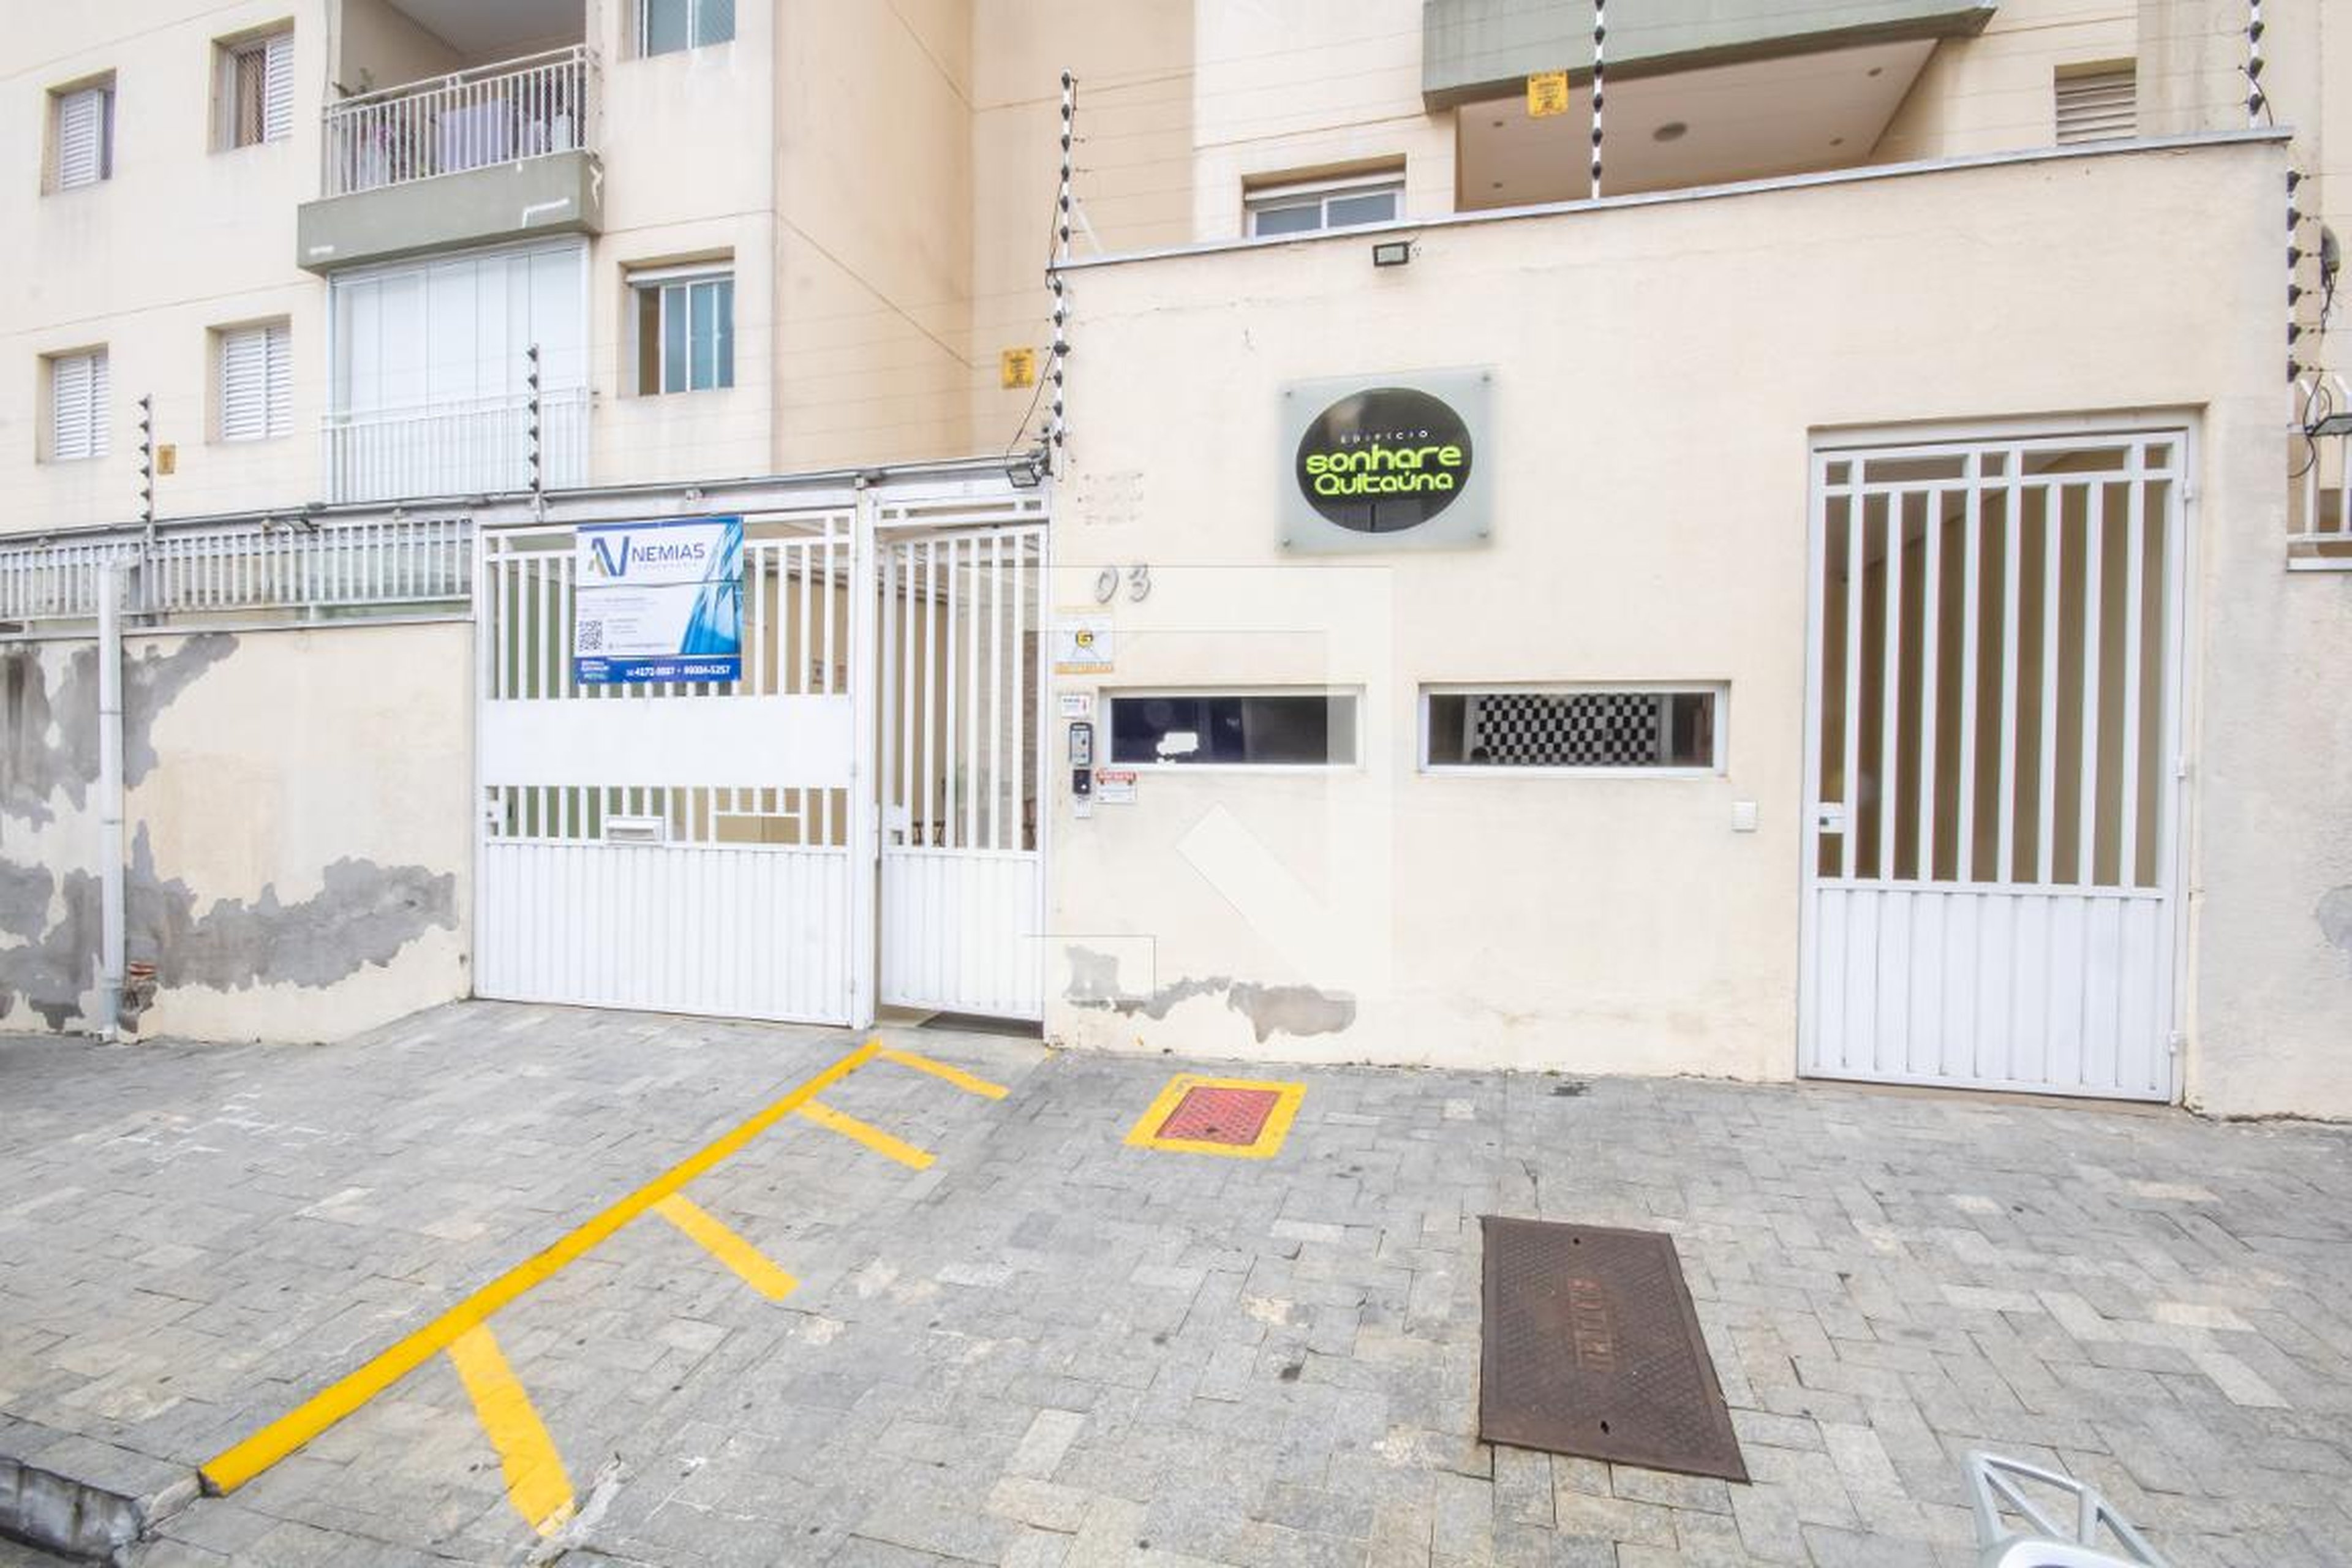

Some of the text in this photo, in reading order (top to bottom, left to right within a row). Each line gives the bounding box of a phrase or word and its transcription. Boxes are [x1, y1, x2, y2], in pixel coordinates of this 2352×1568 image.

[1306, 443, 1462, 474] sonhare
[1314, 470, 1454, 495] Quitaúna
[631, 543, 706, 562] NEMIAS
[1094, 564, 1152, 604] 03
